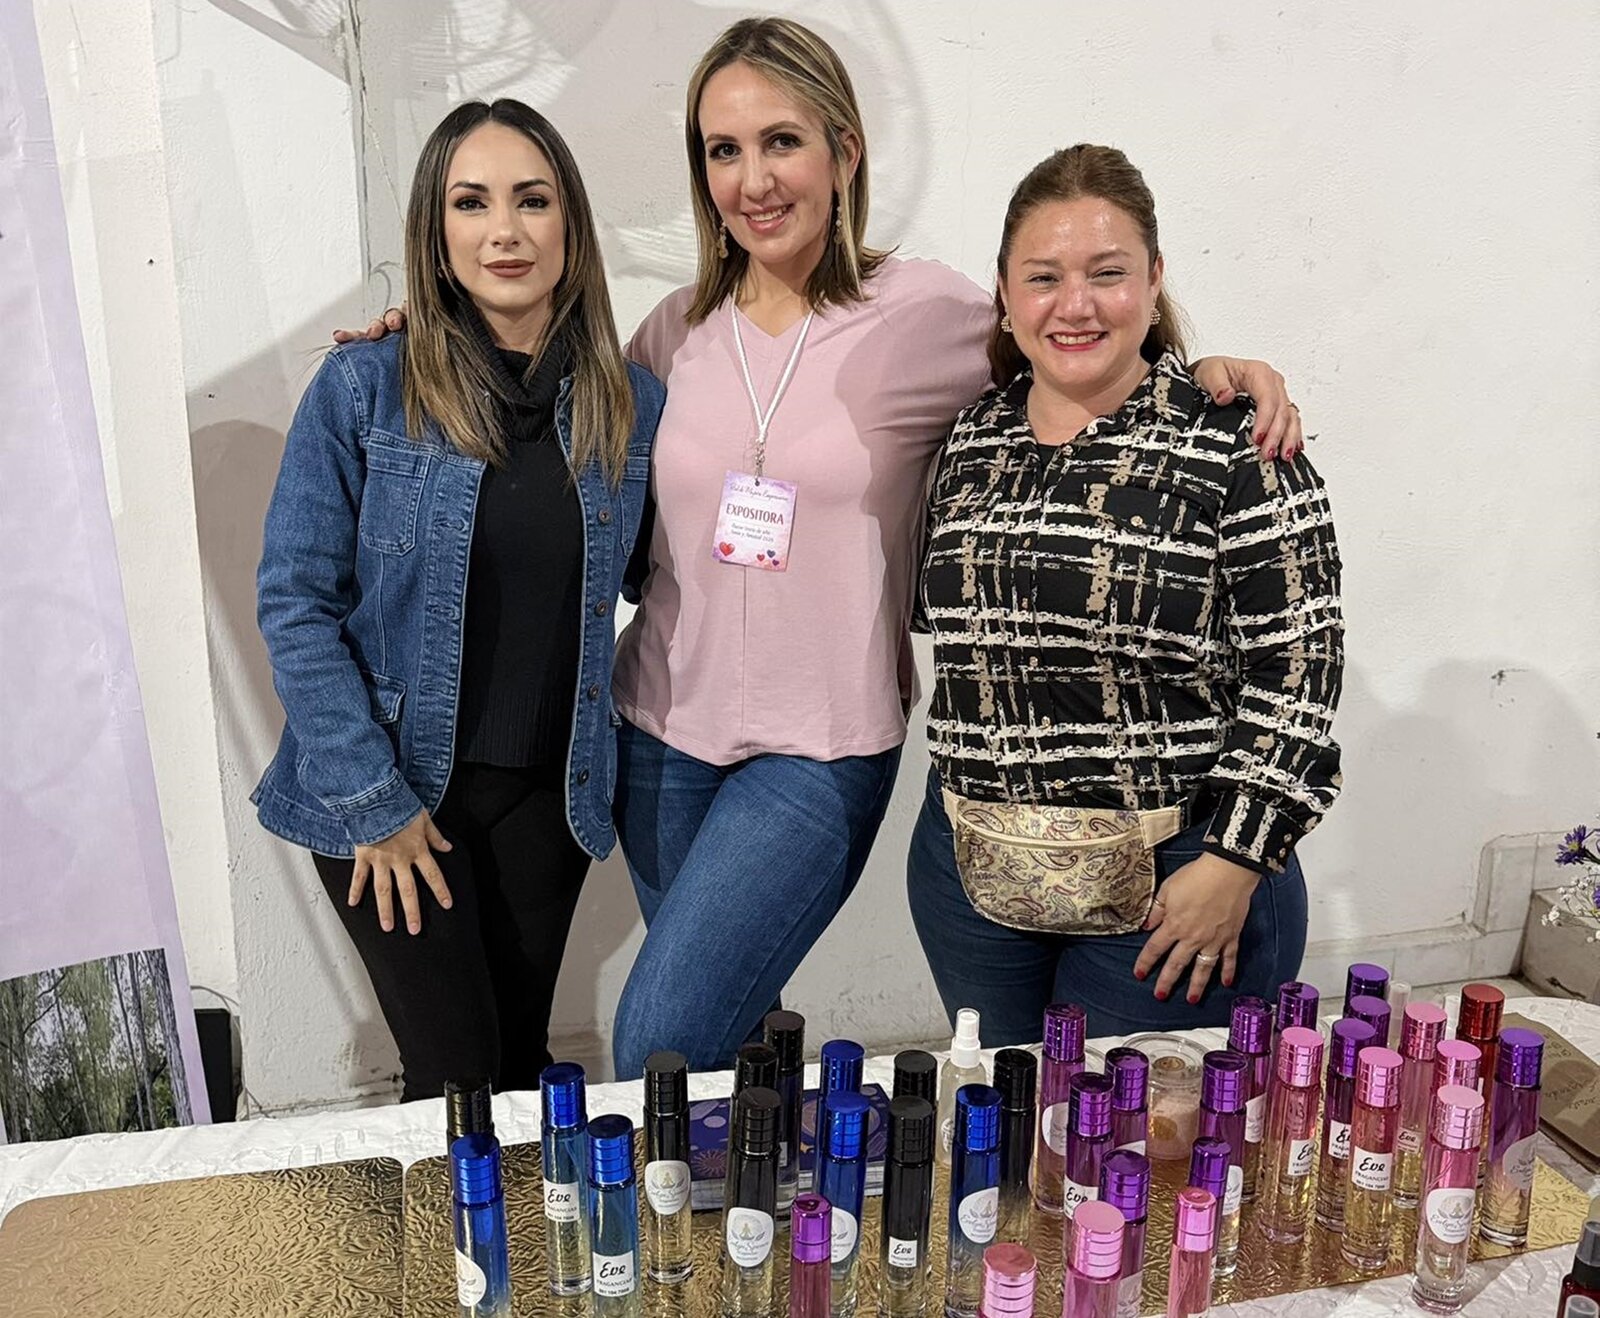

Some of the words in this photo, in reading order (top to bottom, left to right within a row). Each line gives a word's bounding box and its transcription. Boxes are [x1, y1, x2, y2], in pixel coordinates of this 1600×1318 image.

[726, 503, 784, 525] EXPOSITORA
[1398, 1130, 1416, 1142] Eve
[1359, 1156, 1385, 1172] Eve
[547, 1188, 571, 1204] Eve
[894, 1243, 912, 1255] Eve
[599, 1261, 626, 1279] Eve
